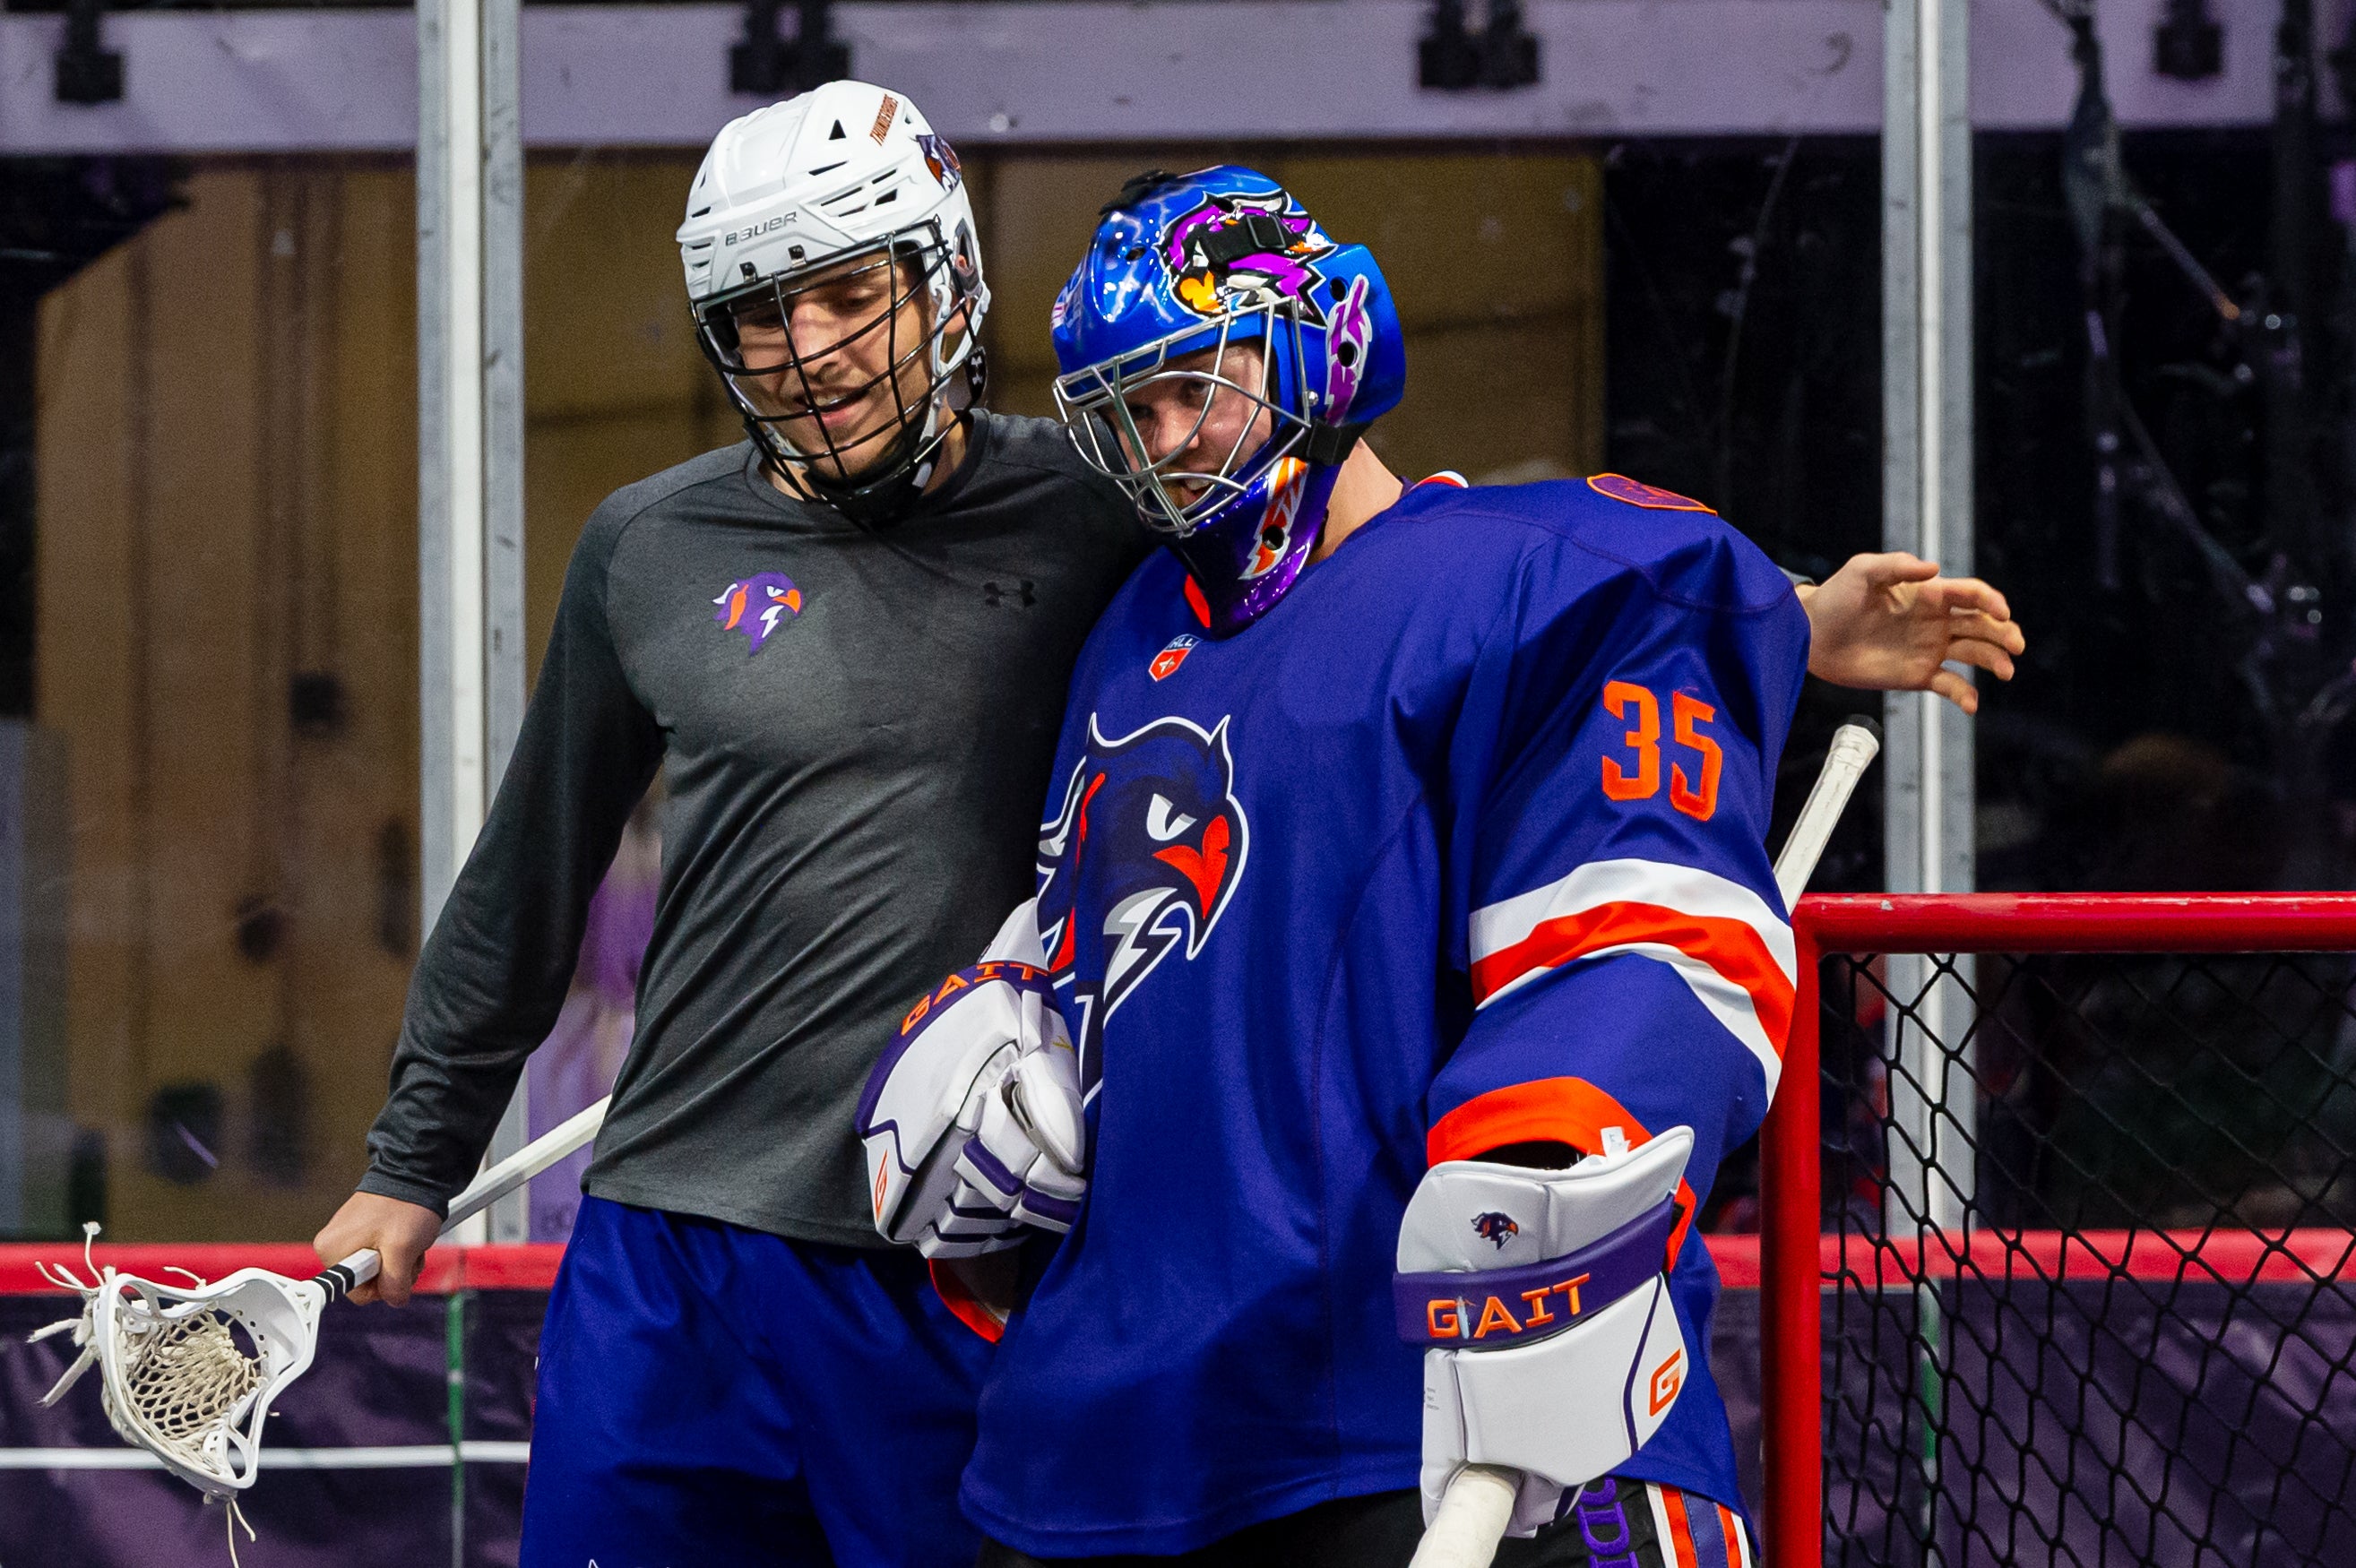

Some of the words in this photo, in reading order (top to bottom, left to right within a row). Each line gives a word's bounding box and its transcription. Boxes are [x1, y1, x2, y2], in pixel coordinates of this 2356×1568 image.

[1602, 679, 1722, 822] 35
[902, 962, 1049, 1036] GAIT
[1427, 1272, 1590, 1339] GAIT
